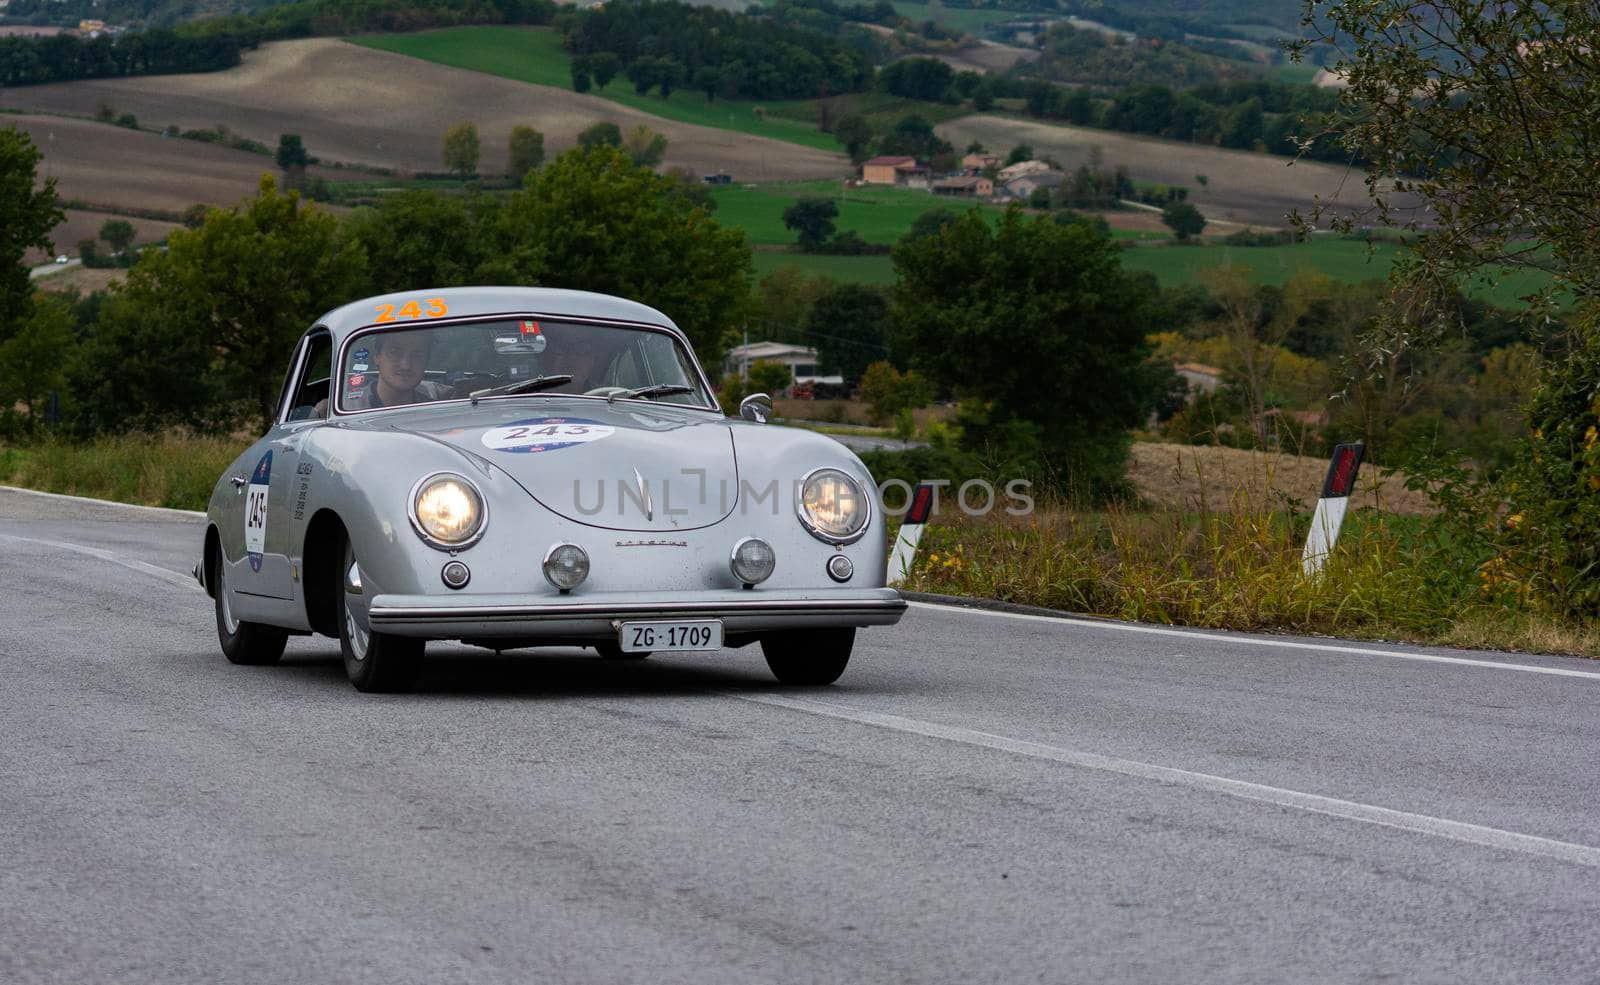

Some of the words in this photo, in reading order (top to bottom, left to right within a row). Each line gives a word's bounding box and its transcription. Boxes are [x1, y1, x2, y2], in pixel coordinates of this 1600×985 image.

[375, 298, 448, 324] 243
[503, 425, 591, 440] 243
[248, 492, 264, 528] 243
